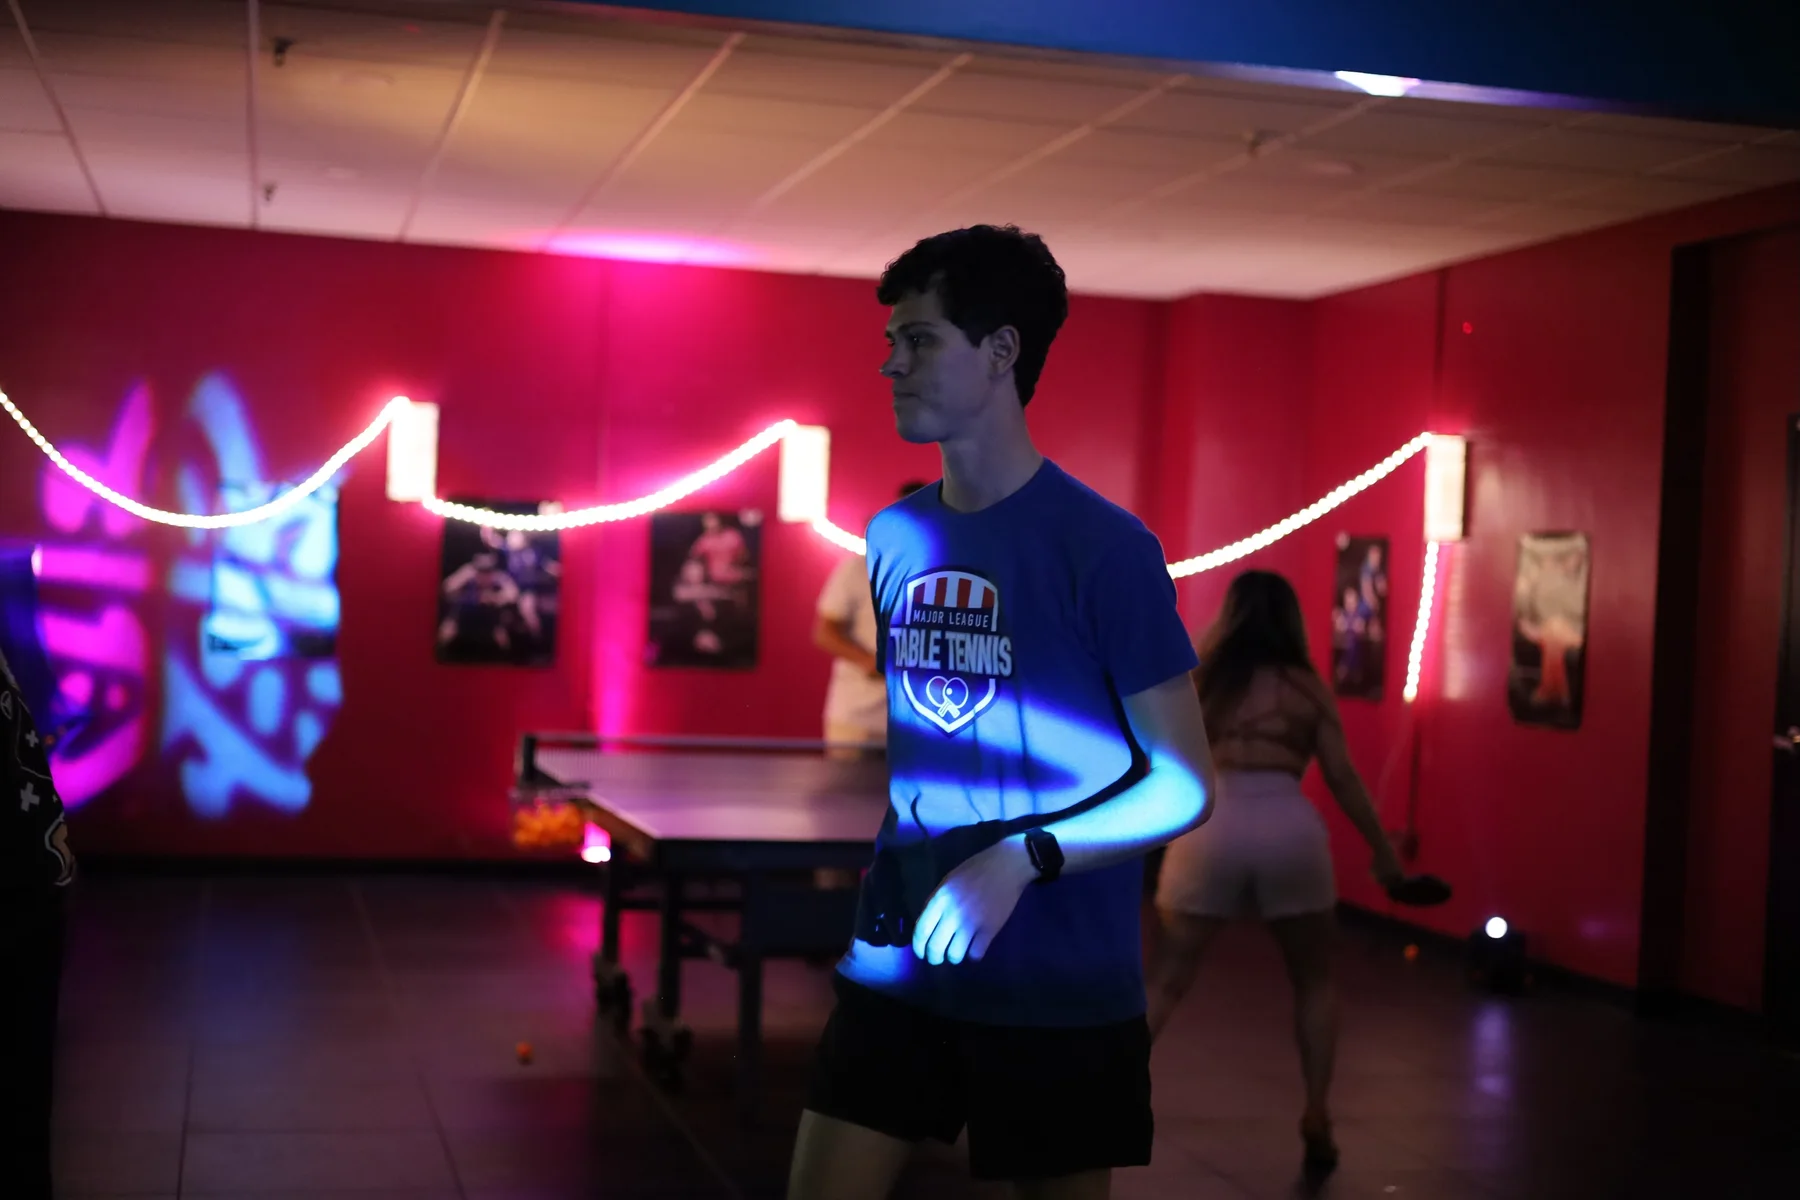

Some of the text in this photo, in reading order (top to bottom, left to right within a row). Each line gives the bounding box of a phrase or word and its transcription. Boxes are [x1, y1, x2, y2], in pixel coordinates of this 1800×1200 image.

[912, 609, 990, 628] MAJOR LEAGUE
[889, 627, 1013, 677] TABLE TENNIS
